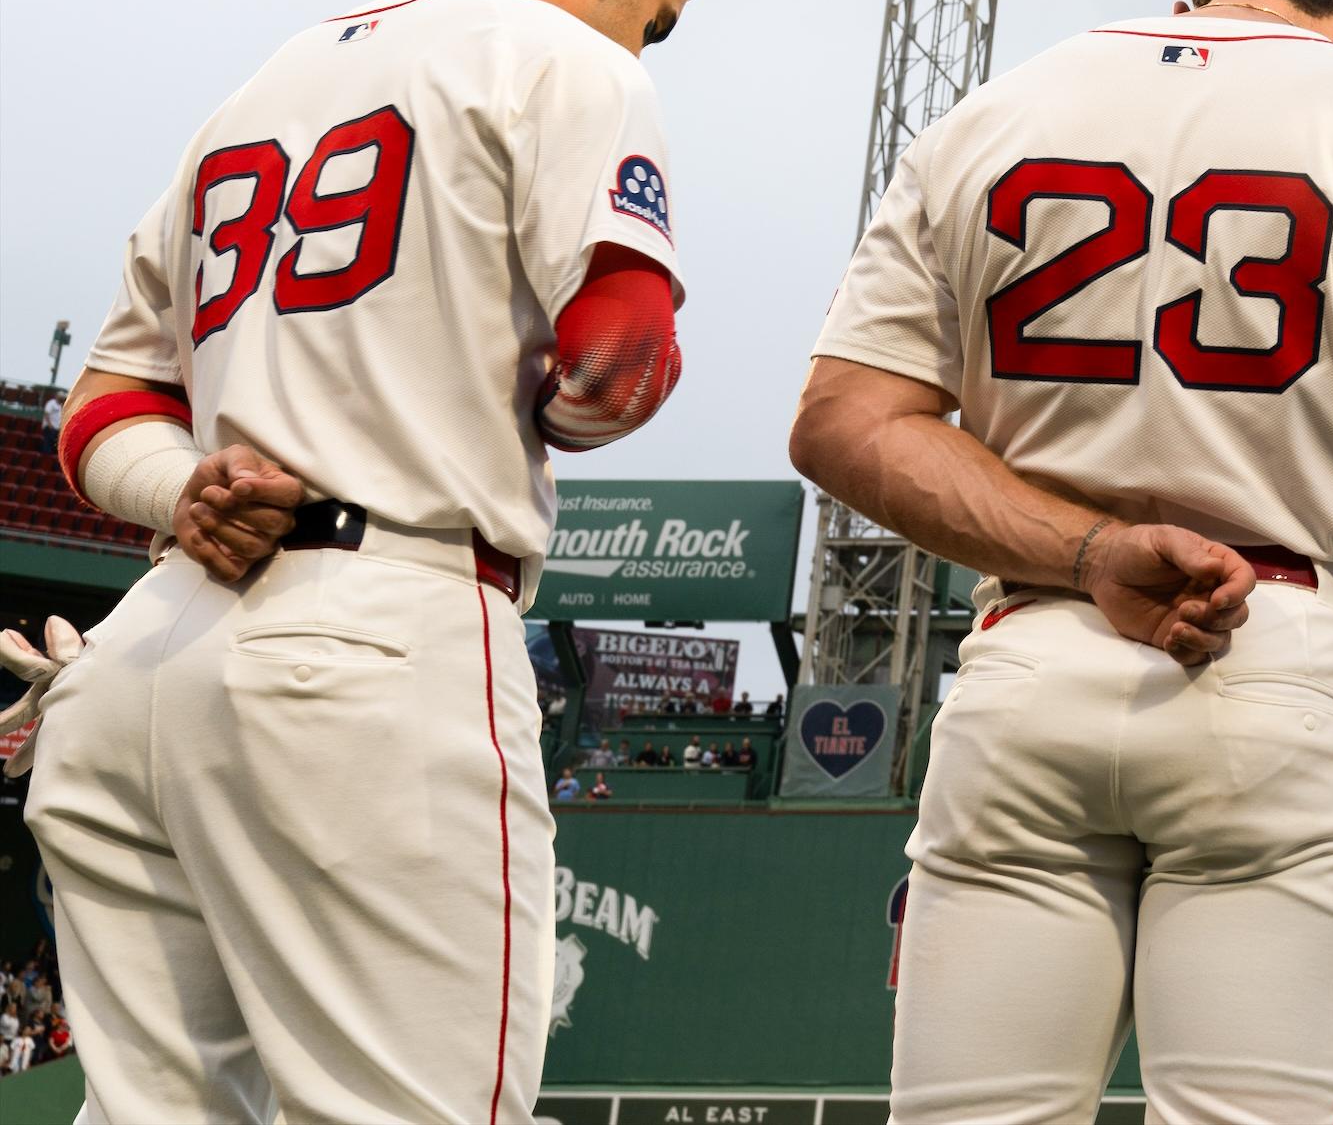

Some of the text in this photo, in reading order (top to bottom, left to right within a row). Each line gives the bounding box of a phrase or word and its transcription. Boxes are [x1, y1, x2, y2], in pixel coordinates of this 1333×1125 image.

[192, 104, 415, 351] 39
[654, 519, 749, 557] Rock
[558, 593, 651, 606] AUTO HOME
[613, 672, 710, 695] ALWAYS A
[832, 716, 852, 735] EL
[815, 736, 867, 754] TIANTE
[555, 866, 655, 960] BEAM
[665, 1107, 769, 1123] AL EAST
